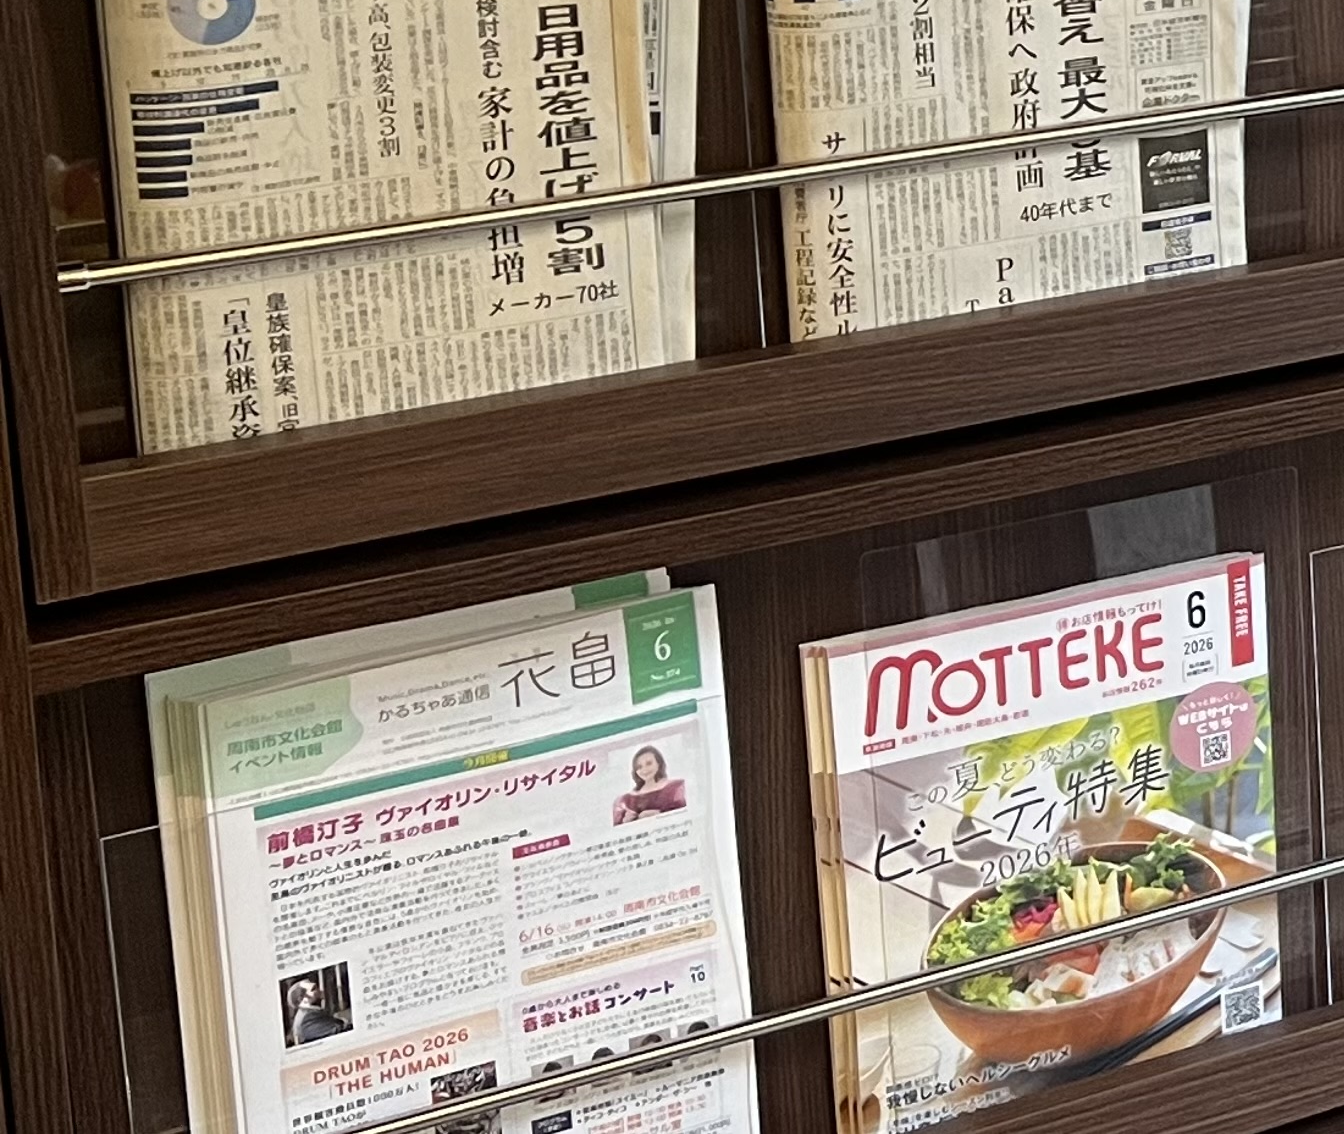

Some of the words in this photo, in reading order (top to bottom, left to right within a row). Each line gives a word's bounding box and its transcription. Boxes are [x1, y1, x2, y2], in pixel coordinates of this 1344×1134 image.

[1058, 56, 1113, 182] 最大基
[1019, 192, 1114, 223] 40年代まで
[821, 131, 859, 337] サリに安全性ル
[488, 279, 620, 318] メーカー70社
[1186, 590, 1207, 629] 6
[1232, 575, 1249, 608] TAKE
[1234, 607, 1249, 638] FREE
[654, 629, 672, 662] 6
[1183, 637, 1214, 656] 2026
[497, 630, 616, 708] 花畠
[378, 683, 490, 723] かるちゃあ通信
[226, 718, 343, 757] 周南市文化会館
[1196, 716, 1234, 735] こちら
[228, 742, 323, 774] イベント情報
[907, 725, 1121, 812] この夏、どう変わる?
[266, 812, 364, 854] 前橋汀子
[375, 759, 596, 827] ヴァイオリン・リサイタル
[874, 743, 1171, 882] ビューティ特集
[979, 832, 1083, 887] 2026年
[518, 923, 554, 943] 6/16
[691, 971, 706, 983] 10
[523, 998, 601, 1033] 音楽とお話
[604, 980, 675, 1010] コンサート
[313, 1056, 371, 1085] DRUM
[378, 1043, 415, 1065] TAO
[422, 1027, 469, 1053] 2026
[886, 1044, 1072, 1110] 我慢しないヘルシーグルメ
